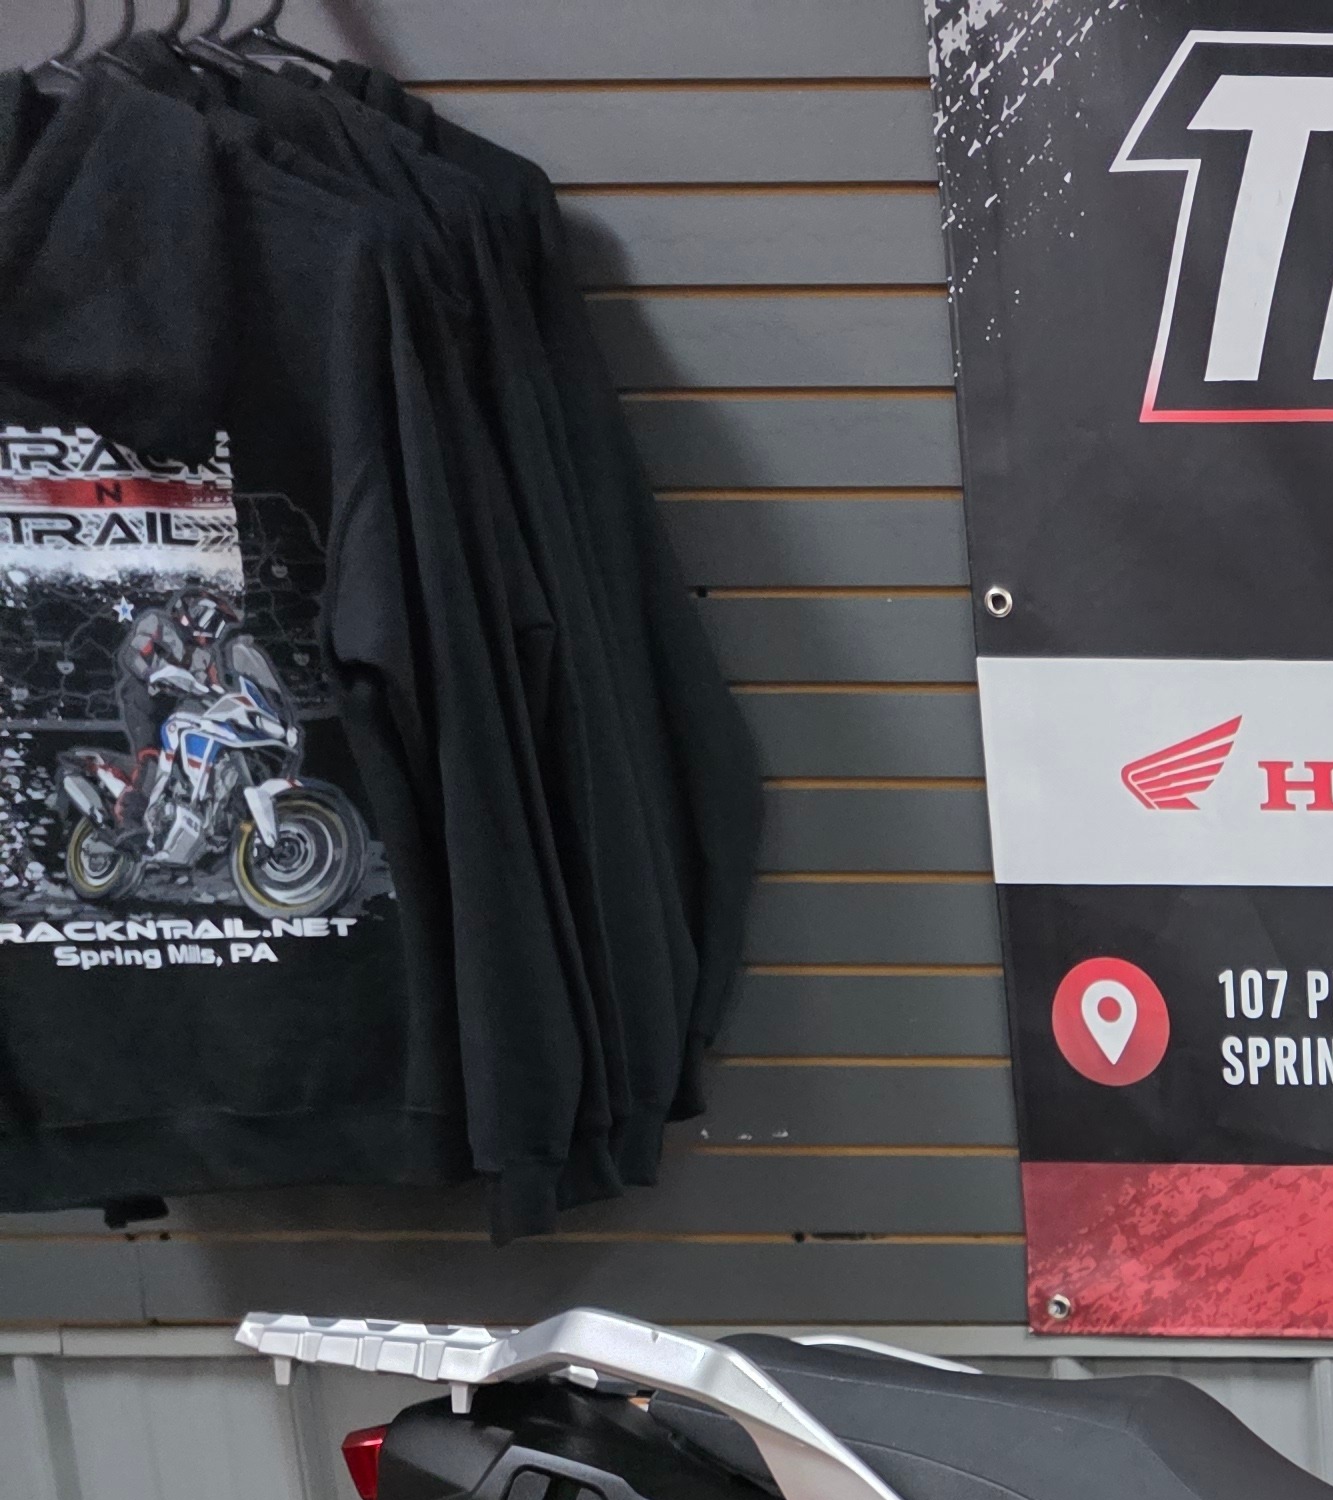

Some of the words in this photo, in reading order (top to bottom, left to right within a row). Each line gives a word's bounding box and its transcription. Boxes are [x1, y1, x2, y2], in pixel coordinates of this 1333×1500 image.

[0, 511, 200, 545] TRAIL
[0, 918, 357, 944] RACKNTRAIL.NET
[54, 945, 163, 970] Spring
[230, 942, 279, 963] PA
[1218, 970, 1288, 1020] 107
